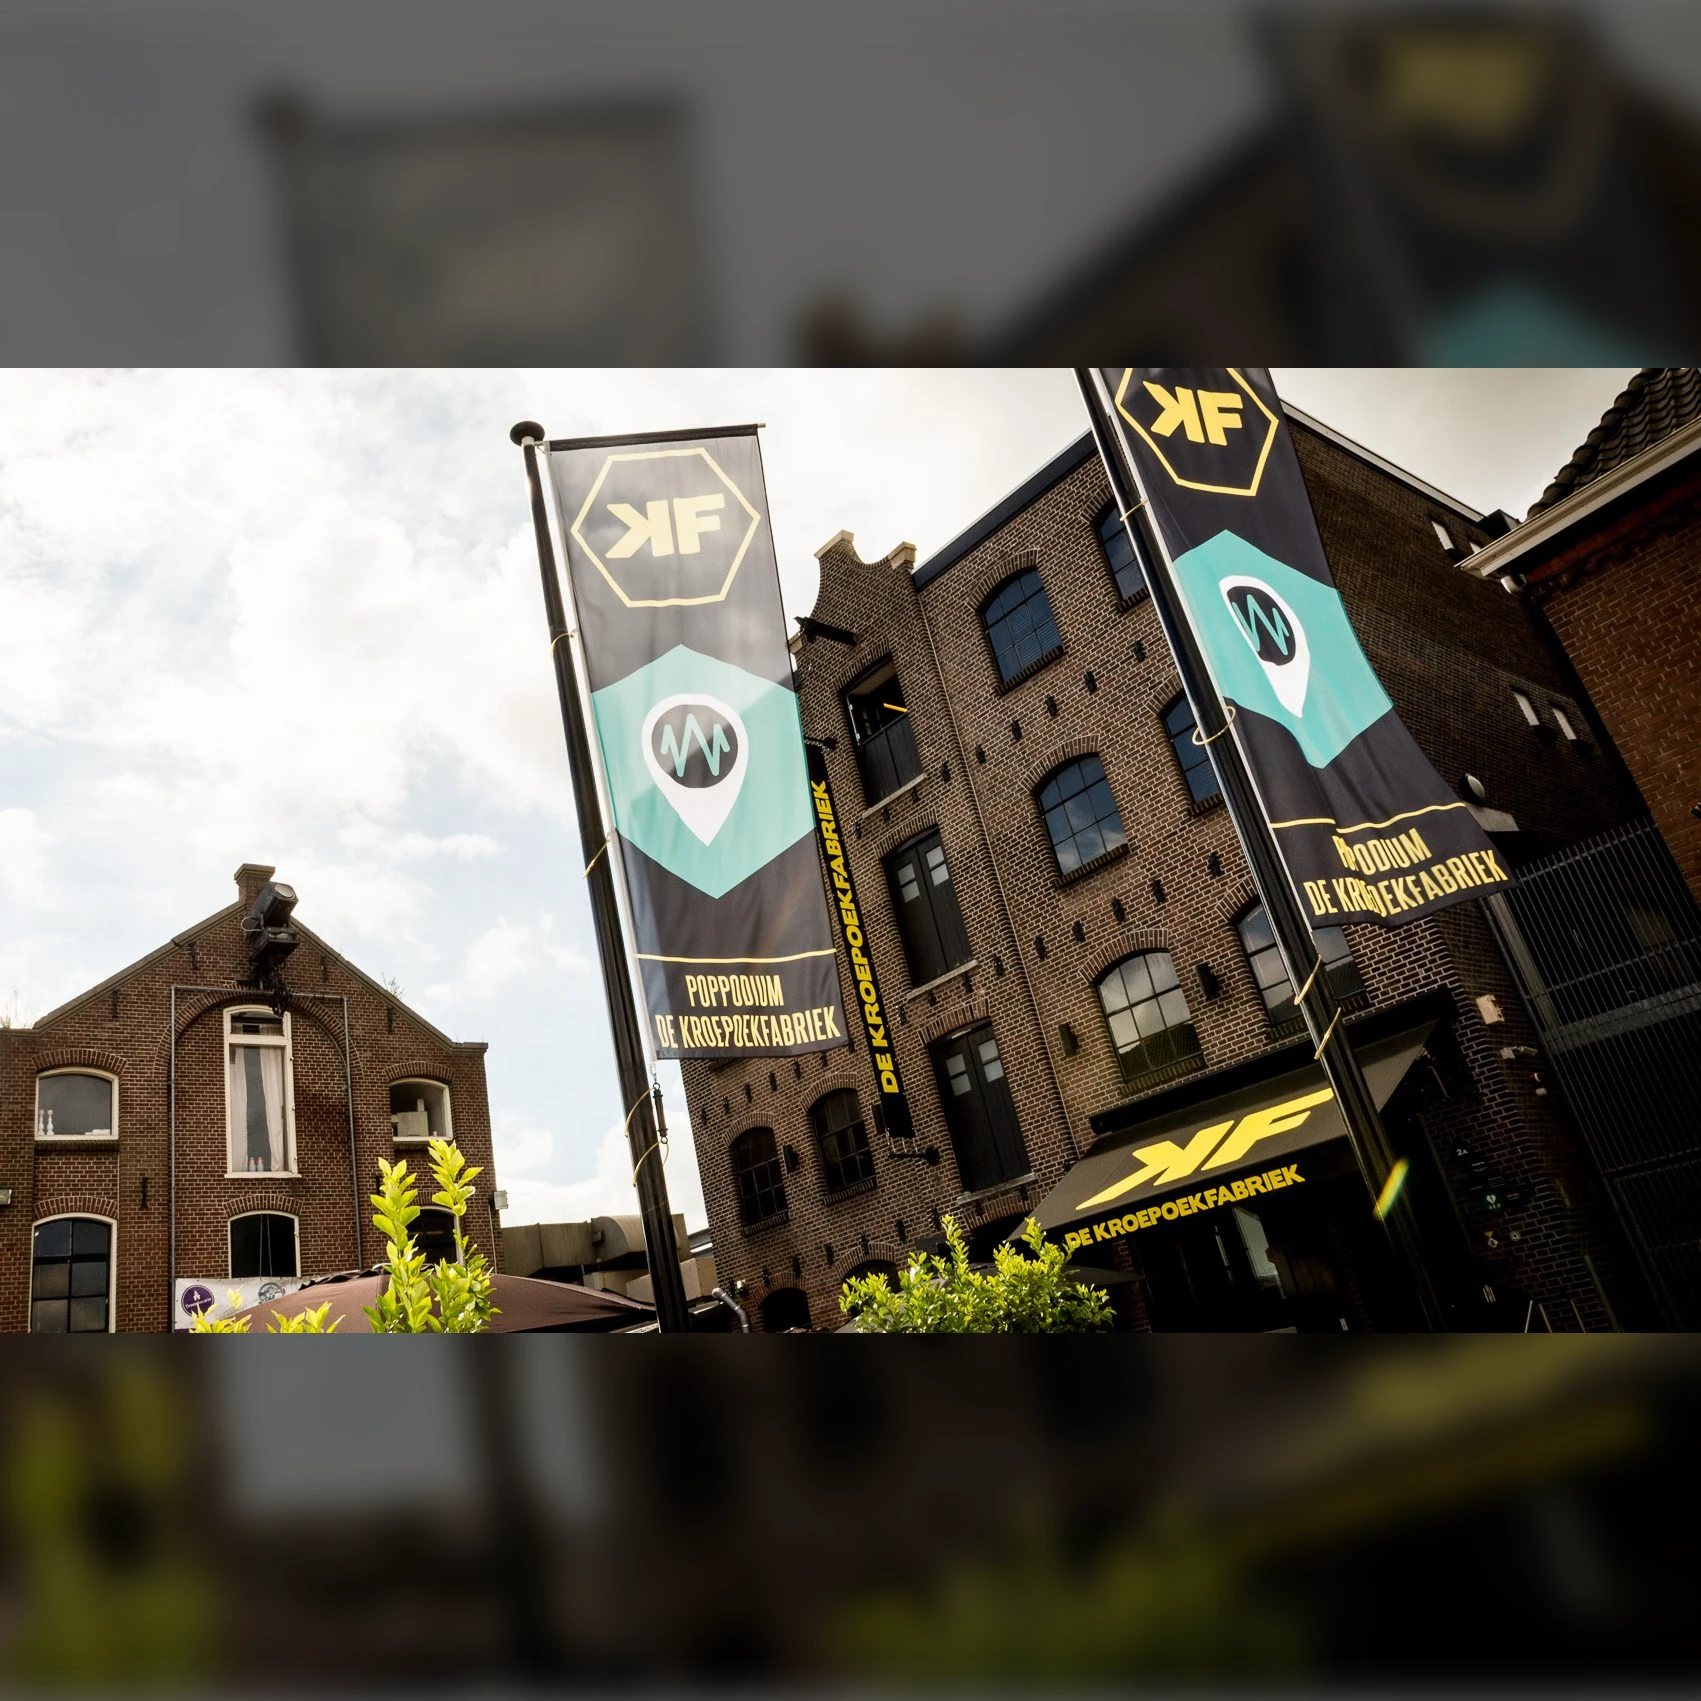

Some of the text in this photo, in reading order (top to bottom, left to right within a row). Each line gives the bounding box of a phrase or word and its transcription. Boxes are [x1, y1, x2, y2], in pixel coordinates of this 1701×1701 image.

[1303, 879, 1338, 916] DE
[810, 780, 900, 1094] DE KROEPOEKFABRIEK
[685, 974, 785, 1008] POPPODIUM
[655, 1005, 842, 1049] DE KROEPOEKFABRIEK
[1064, 1164, 1306, 1251] DE KROEPOEKFABRIEK
